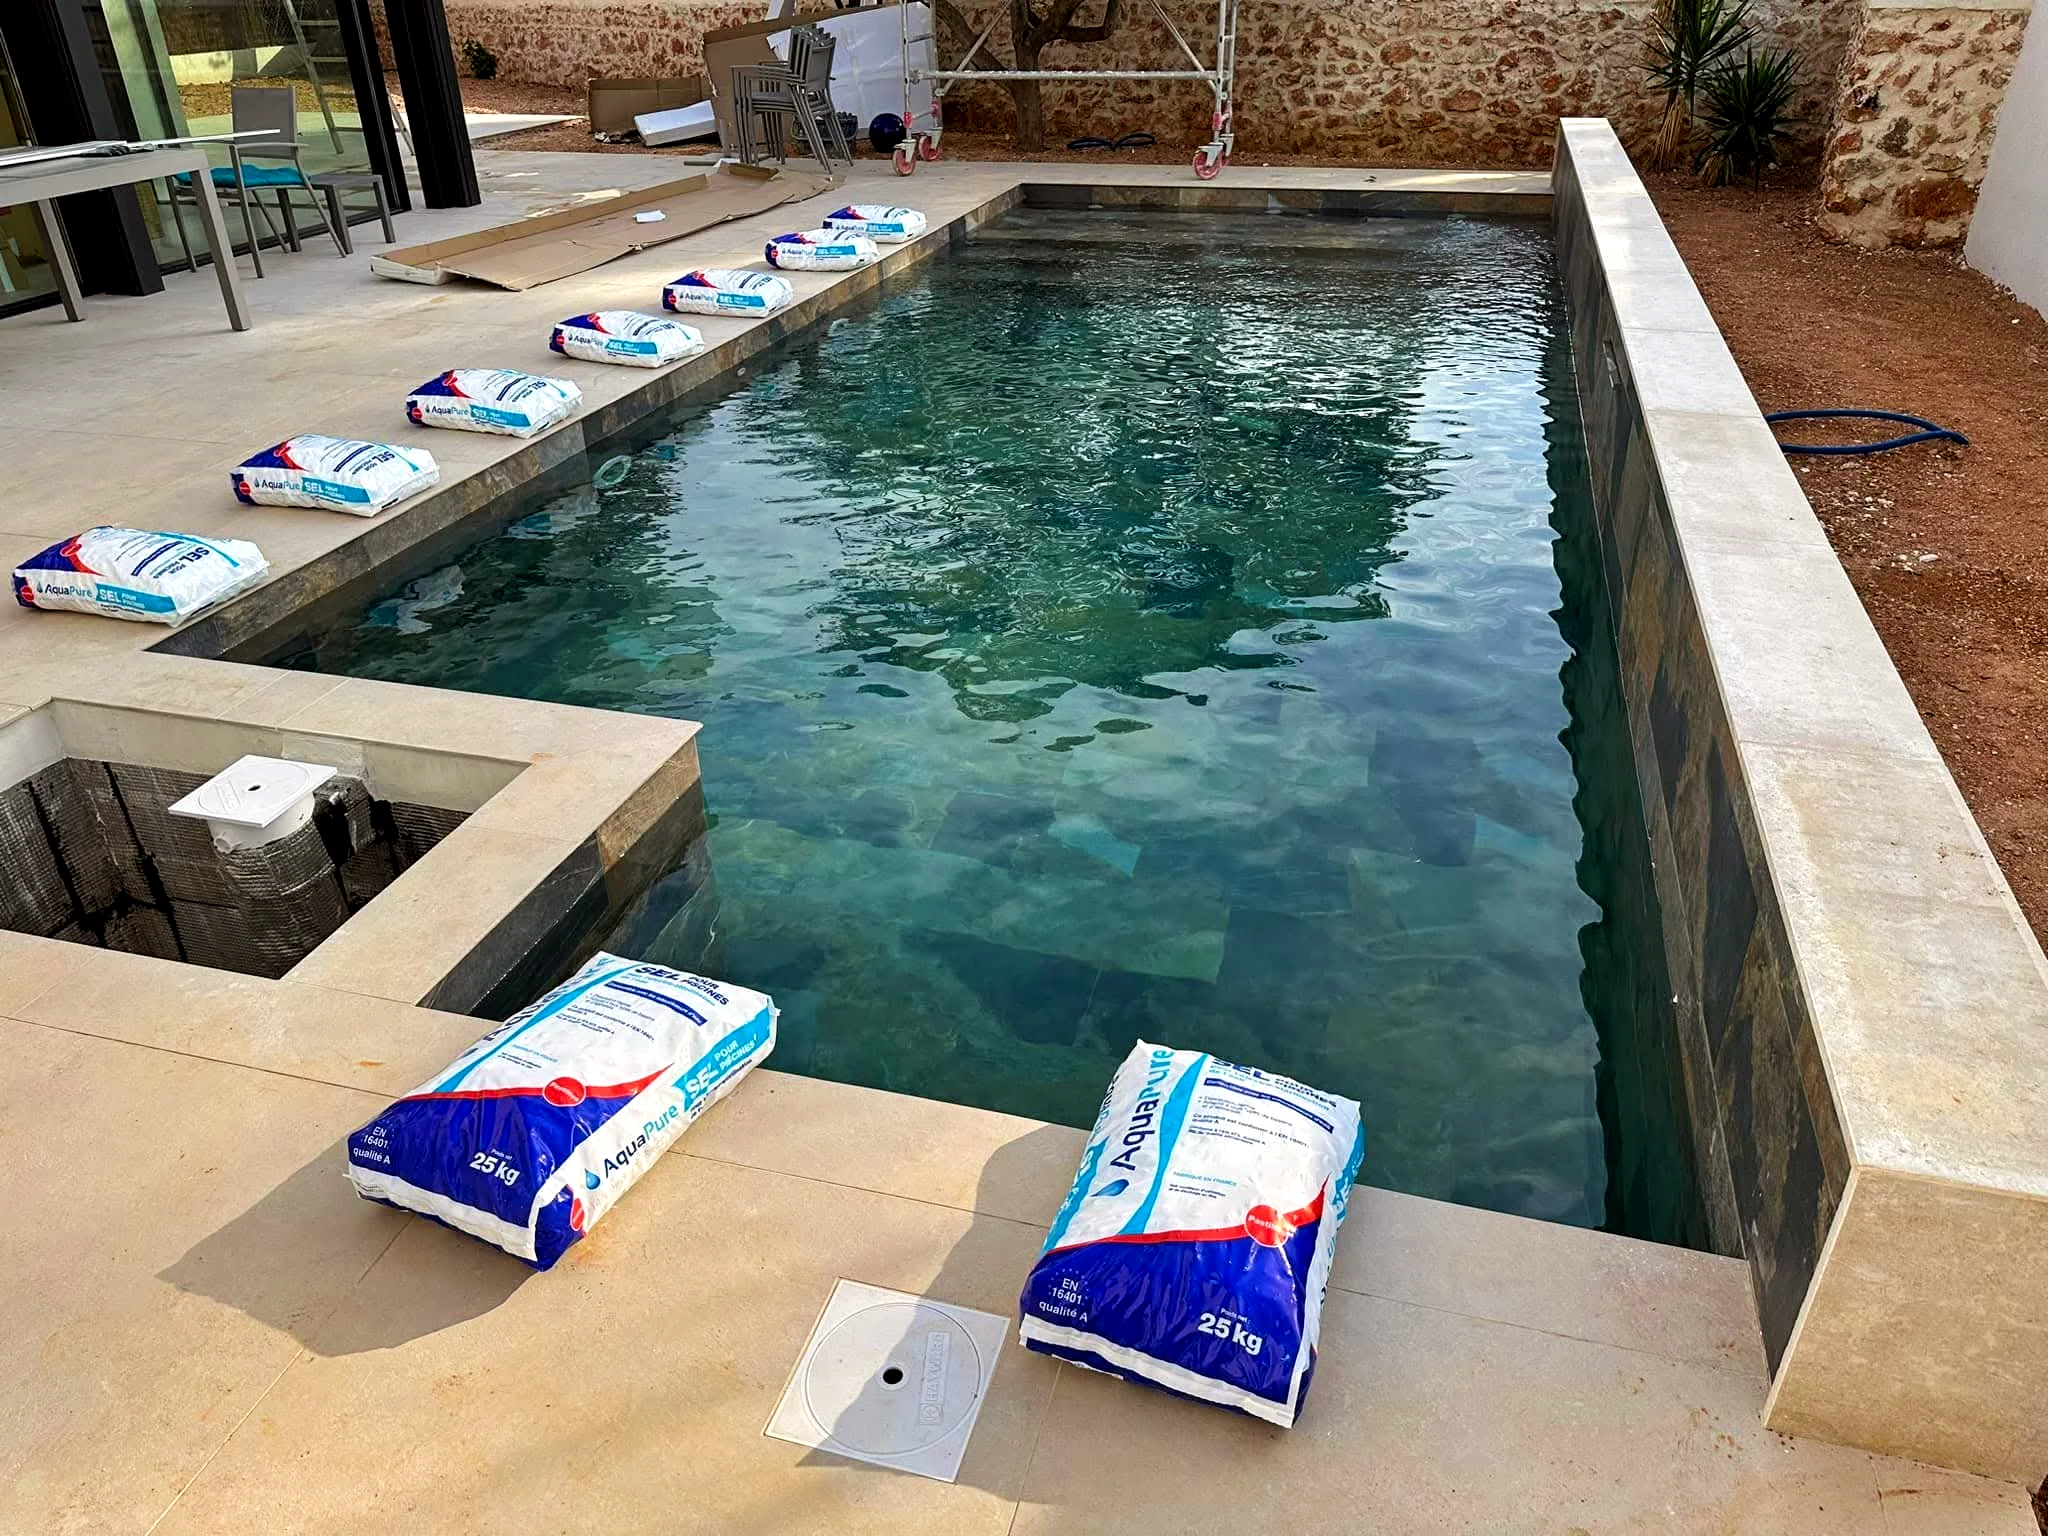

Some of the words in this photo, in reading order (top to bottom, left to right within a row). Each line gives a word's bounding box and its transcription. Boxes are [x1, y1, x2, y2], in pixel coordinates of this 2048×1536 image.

[261, 480, 300, 490] AquaPue
[305, 482, 324, 492] SEL
[179, 547, 210, 562] SEL
[45, 584, 92, 598] AquaPure
[99, 589, 121, 602] SEL
[635, 966, 681, 981] SEL
[715, 1040, 738, 1062] POUR
[686, 1062, 720, 1100] SEL
[1110, 1050, 1175, 1172] AquaPure
[373, 1126, 387, 1138] EN
[364, 1134, 388, 1149] 16401
[603, 1104, 680, 1179] AquaPure
[353, 1147, 383, 1162] qualité
[383, 1155, 391, 1165] A
[469, 1151, 498, 1174] 25
[494, 1160, 520, 1186] kg
[1062, 1277, 1079, 1292] EN
[1052, 1287, 1082, 1305] 16401
[1039, 1301, 1078, 1318] qualité
[1079, 1312, 1088, 1323] A
[1198, 1312, 1231, 1339] 25
[1232, 1322, 1262, 1356] kg
